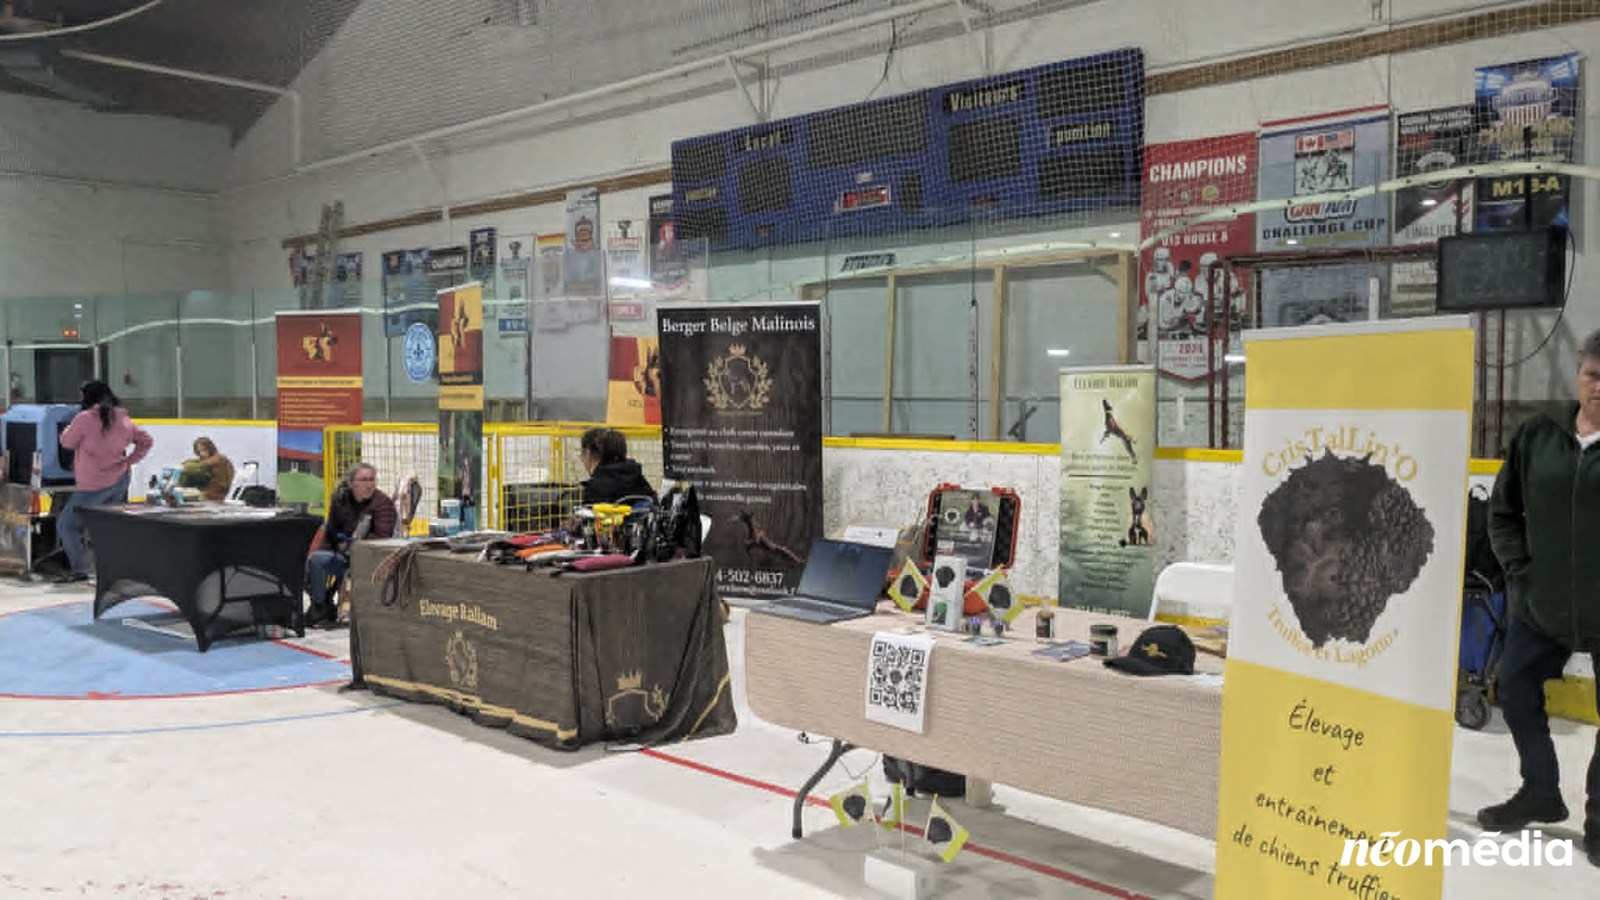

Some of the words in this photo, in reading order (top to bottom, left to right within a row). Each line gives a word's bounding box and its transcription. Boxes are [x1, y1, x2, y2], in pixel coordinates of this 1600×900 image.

[1149, 155, 1247, 183] CHAMPIONS
[1262, 222, 1347, 240] CHALLENGE
[1353, 217, 1385, 232] CUP
[662, 317, 707, 338] Berger
[710, 315, 748, 338] Belge
[751, 314, 816, 332] Malinois
[1288, 697, 1365, 751] Élevage
[1313, 764, 1338, 786] et
[1232, 824, 1254, 847] de
[1258, 836, 1320, 876] chiens
